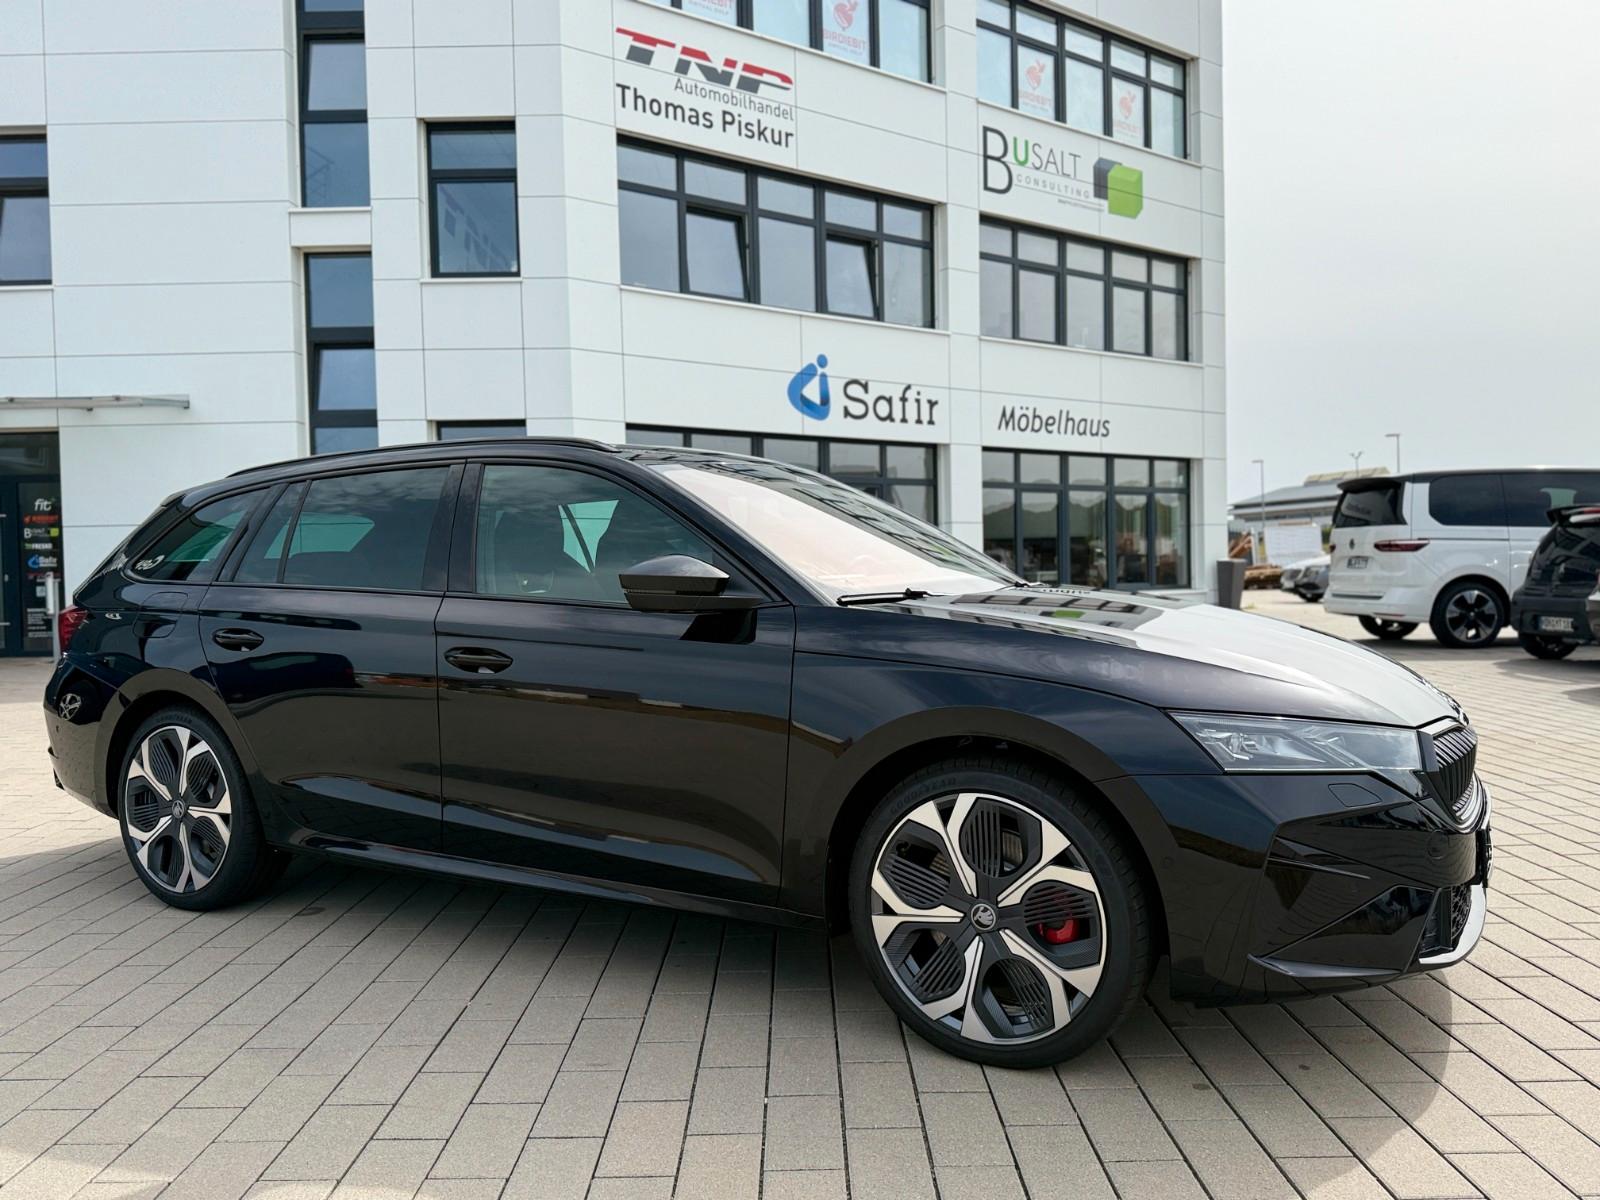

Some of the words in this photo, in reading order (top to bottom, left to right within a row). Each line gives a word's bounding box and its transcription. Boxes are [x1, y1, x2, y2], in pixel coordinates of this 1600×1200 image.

[616, 27, 794, 94] TNP
[616, 83, 714, 129] Thomas
[721, 110, 794, 148] Piskur
[674, 78, 794, 121] Automobilhandel
[1016, 174, 1090, 200] CONSULTING
[843, 379, 939, 426] Safir
[998, 405, 1110, 438] Möbelhaus
